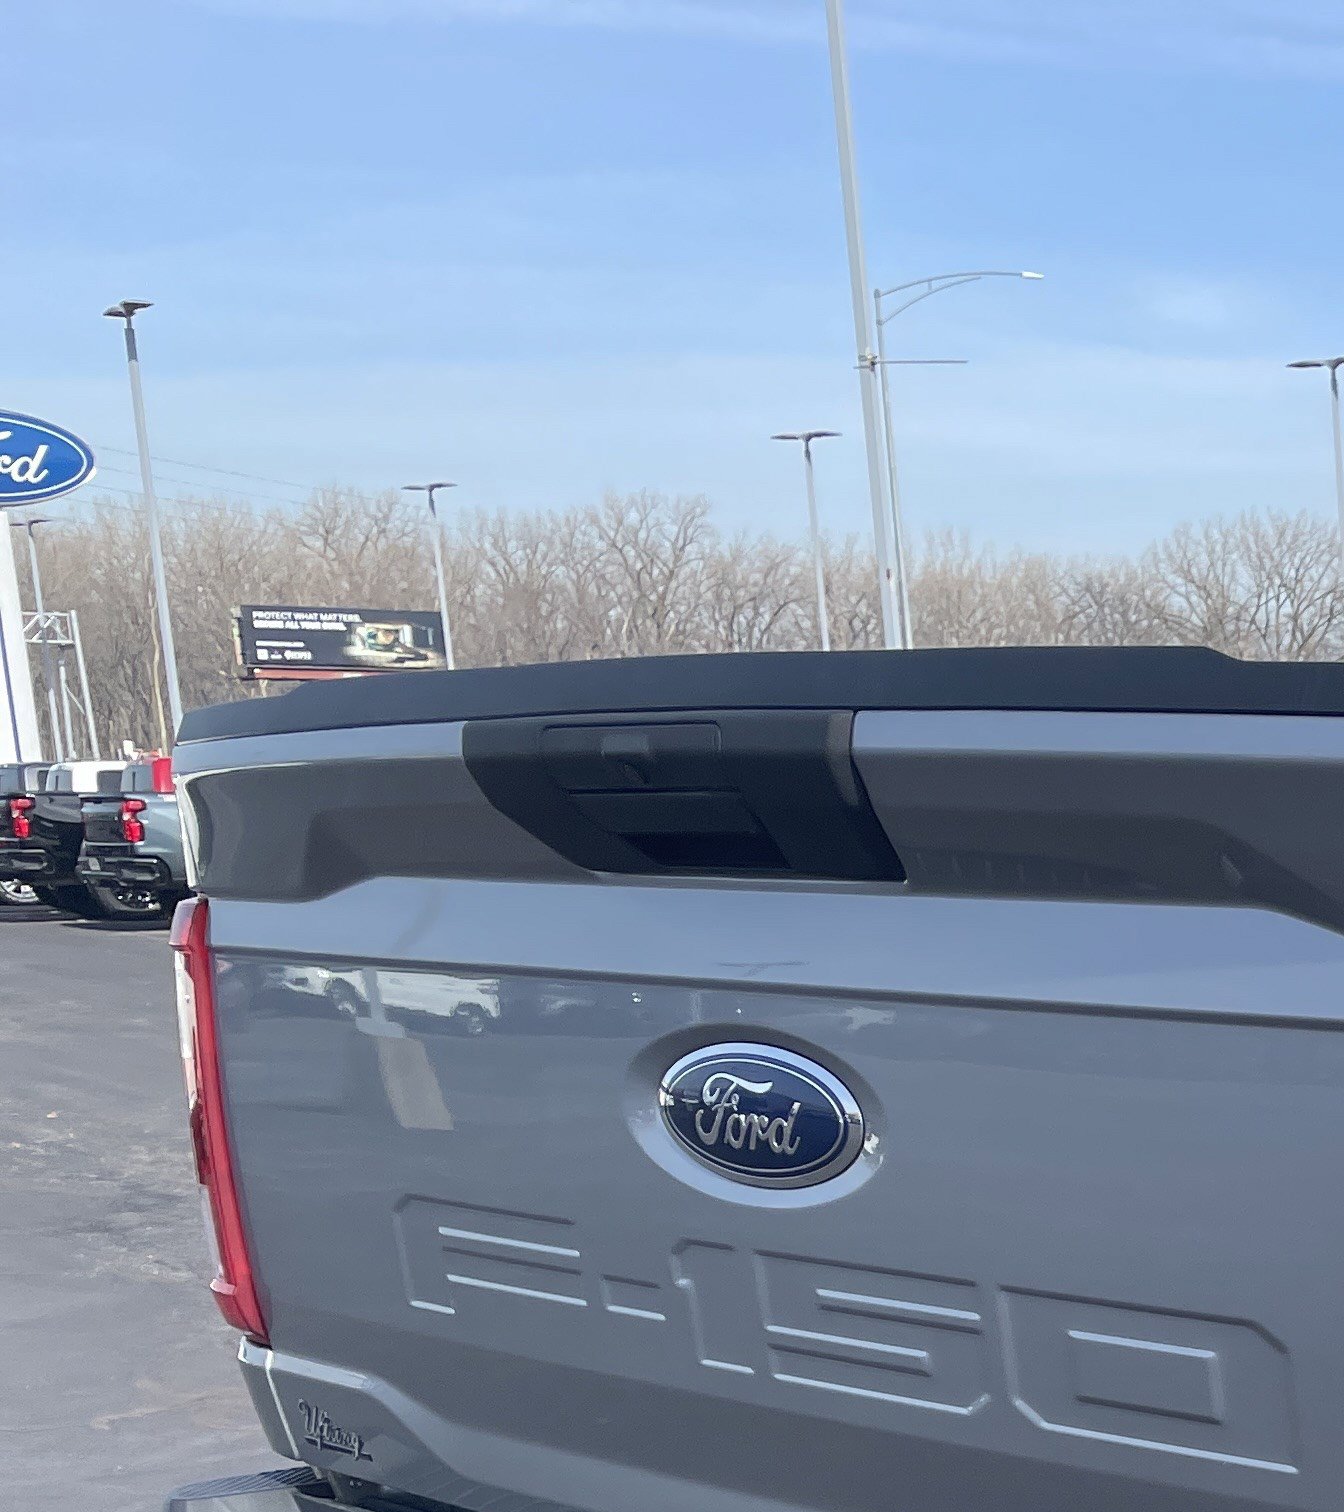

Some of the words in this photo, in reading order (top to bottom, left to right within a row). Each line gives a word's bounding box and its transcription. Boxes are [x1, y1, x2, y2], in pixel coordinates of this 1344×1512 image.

[252, 611, 292, 620] PROTECT
[293, 612, 319, 621] WHAT
[695, 1072, 802, 1155] Ford
[393, 1194, 1299, 1474] F-150
